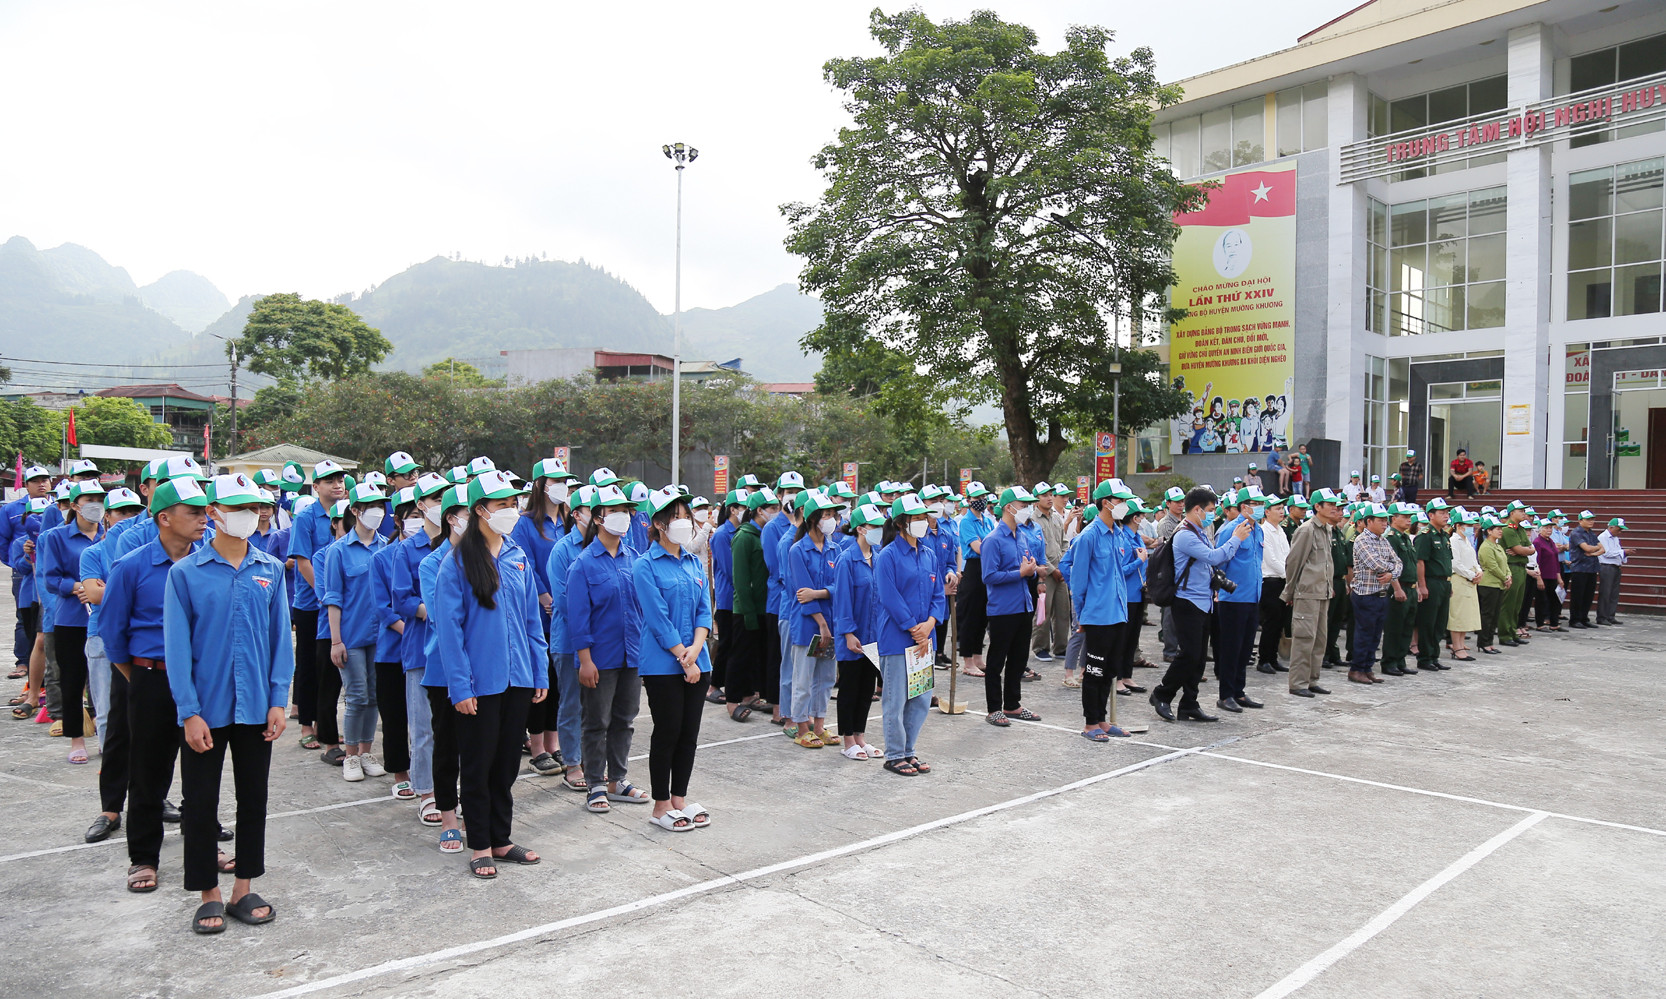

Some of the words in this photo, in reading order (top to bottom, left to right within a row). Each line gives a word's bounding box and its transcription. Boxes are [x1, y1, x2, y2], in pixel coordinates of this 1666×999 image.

[1385, 133, 1449, 162] TRUNG
[1456, 122, 1500, 148] TÂM
[1508, 109, 1545, 138] HỘI
[1554, 96, 1612, 127] NGHỊ
[1216, 290, 1242, 304] THỨ
[1244, 288, 1275, 301] XXIV
[1209, 305, 1230, 315] HUYỆN
[1224, 324, 1241, 334] TRONG
[1574, 355, 1589, 367] XÂ
[1566, 370, 1589, 382] ĐOÀ
